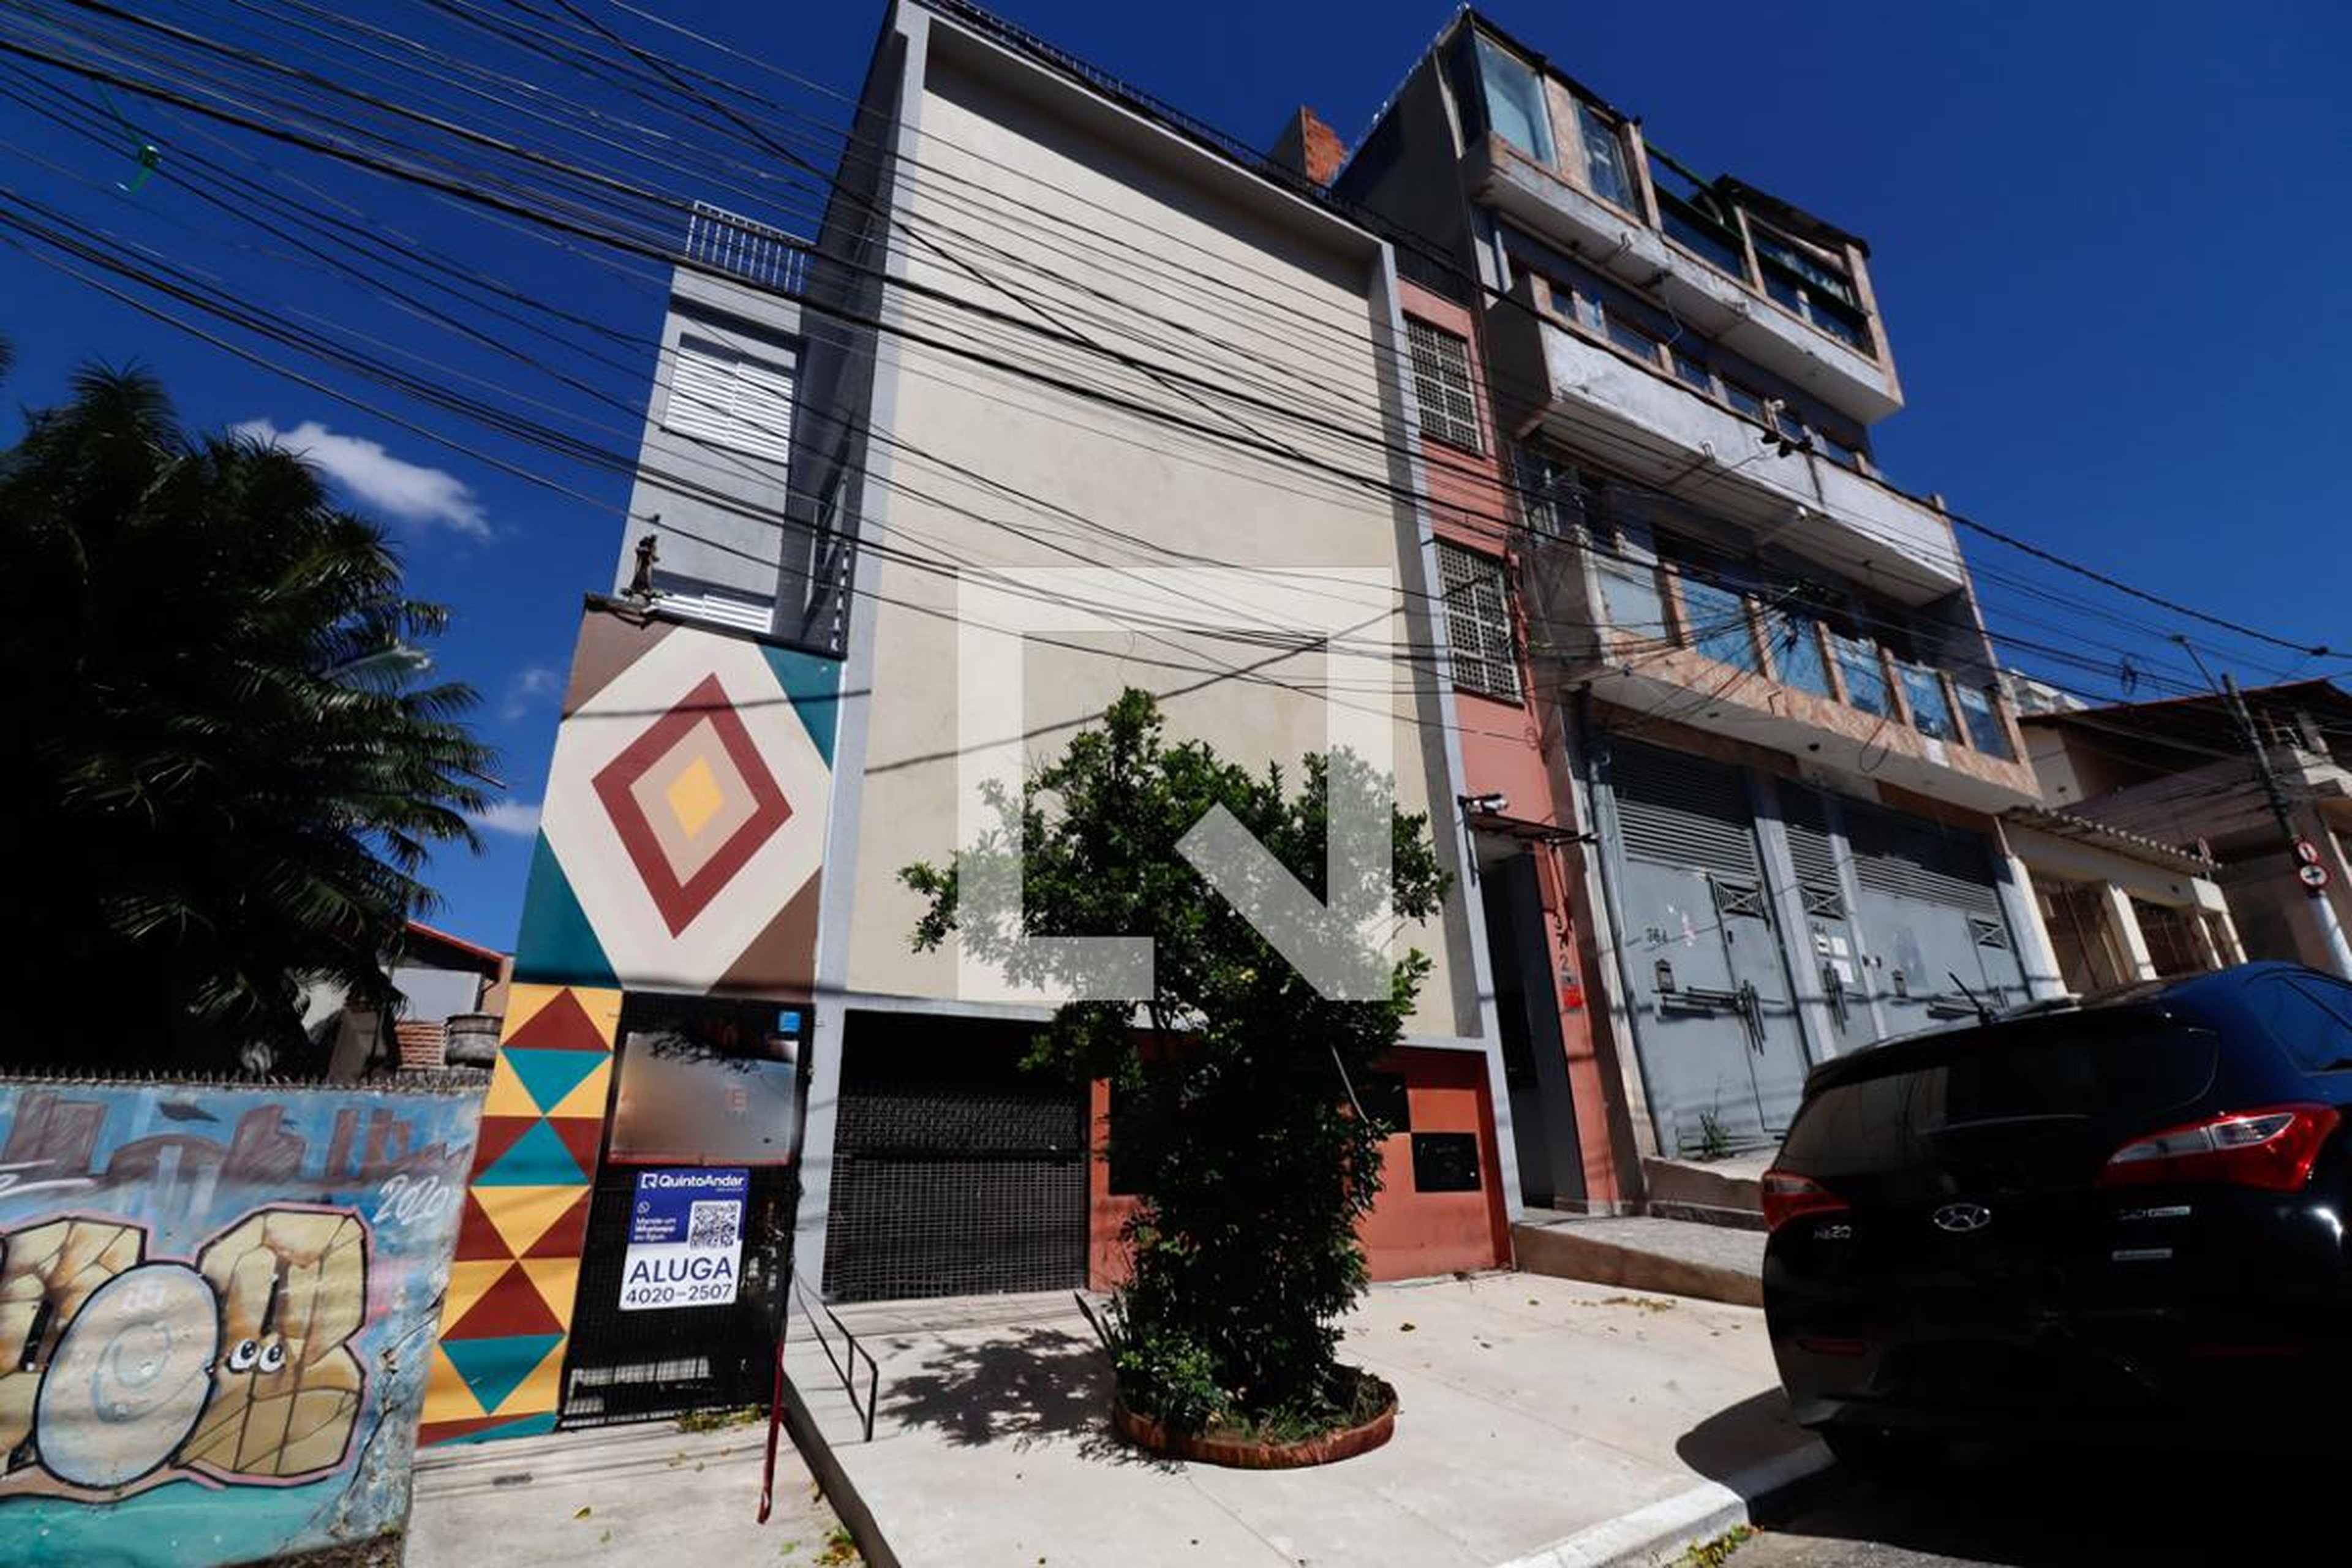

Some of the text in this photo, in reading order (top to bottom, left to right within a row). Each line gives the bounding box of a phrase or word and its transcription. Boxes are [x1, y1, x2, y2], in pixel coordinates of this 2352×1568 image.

[658, 1174, 745, 1188] QuintoAndar
[372, 1174, 451, 1224] 2020
[630, 1257, 733, 1284] ALUGA
[626, 1284, 732, 1304] 4020-2507
